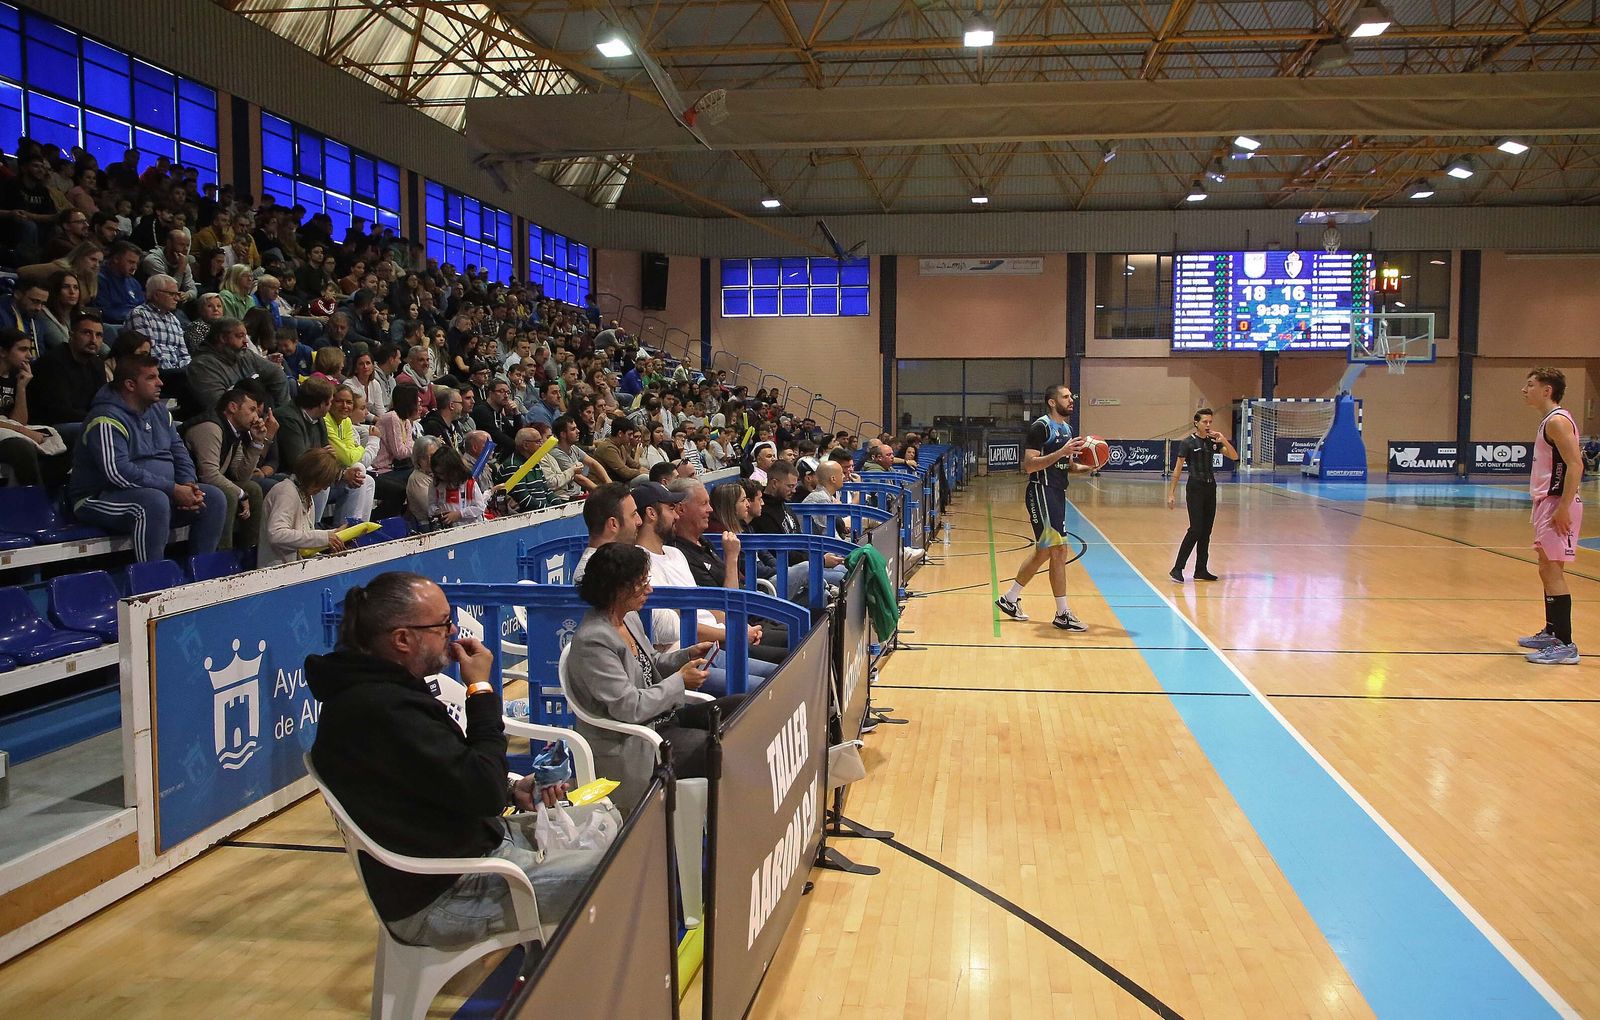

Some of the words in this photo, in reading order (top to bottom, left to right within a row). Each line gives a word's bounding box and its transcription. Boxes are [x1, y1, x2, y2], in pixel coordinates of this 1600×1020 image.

[1383, 278, 1399, 290] 14
[1242, 285, 1266, 301] 18
[1281, 285, 1305, 301] 16
[990, 448, 1016, 461] LAPITANZA
[1128, 451, 1159, 463] Troya
[1476, 445, 1526, 462] NOP
[1400, 458, 1455, 468] GRAMMY
[274, 668, 308, 700] Ayu
[275, 715, 294, 740] de
[300, 699, 323, 729] Al
[767, 700, 809, 815] TALLER
[748, 805, 801, 951] AARON
